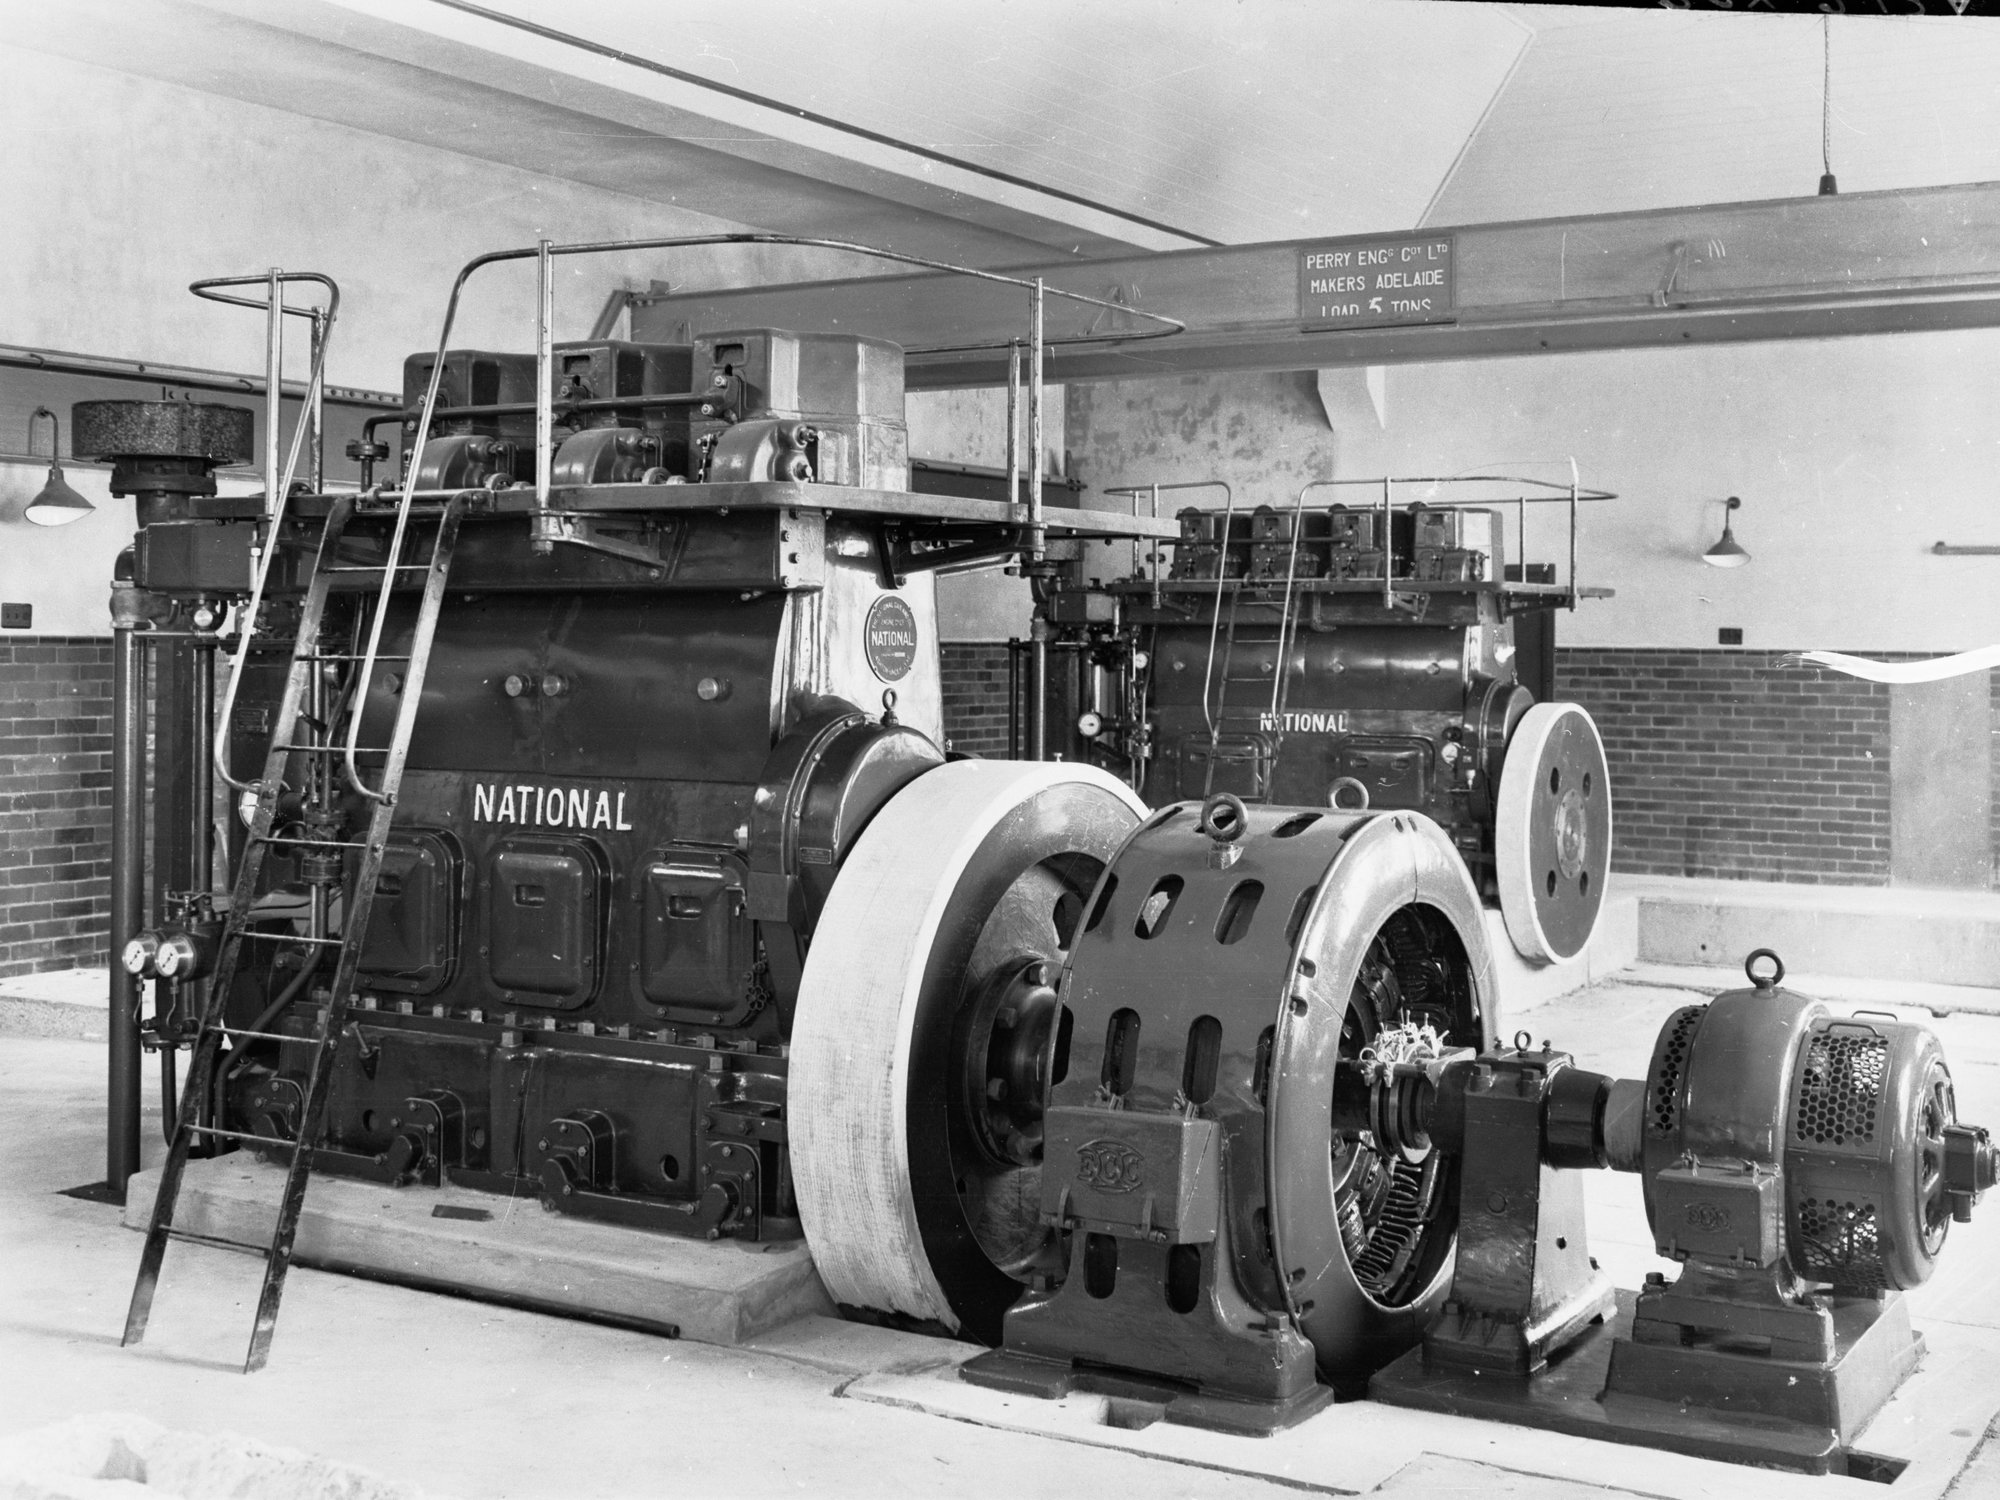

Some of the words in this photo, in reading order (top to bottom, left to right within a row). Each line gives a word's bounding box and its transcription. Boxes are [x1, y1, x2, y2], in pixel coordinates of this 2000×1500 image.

[1306, 252, 1351, 269] PERRY
[1310, 276, 1366, 294] MAKERS
[1375, 269, 1444, 289] ADELAIDE
[1368, 296, 1383, 314] 5
[1390, 297, 1432, 312] TONS
[871, 630, 914, 647] NATIONAL
[474, 783, 632, 831] NATIONAL
